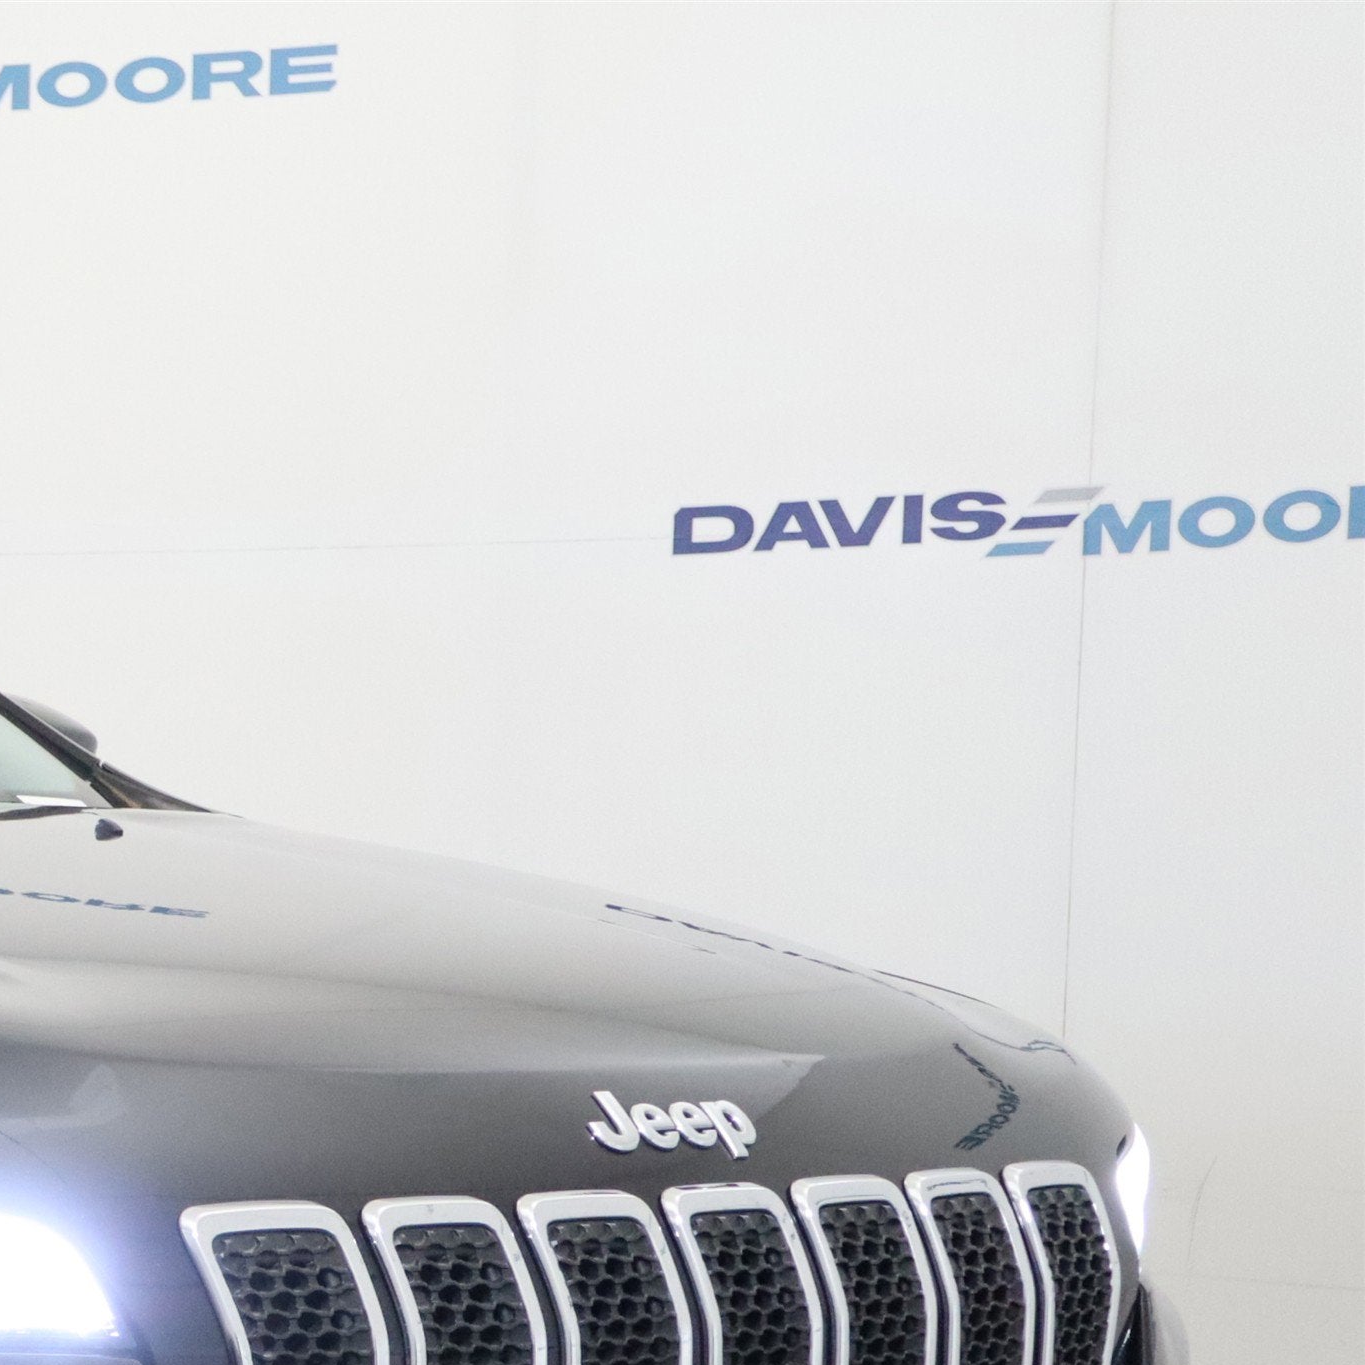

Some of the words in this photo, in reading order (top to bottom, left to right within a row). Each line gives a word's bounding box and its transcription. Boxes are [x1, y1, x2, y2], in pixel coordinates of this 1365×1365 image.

[672, 490, 1007, 556] DAVIS
[1082, 486, 1365, 556] MOO
[585, 1090, 757, 1161] Jeep
